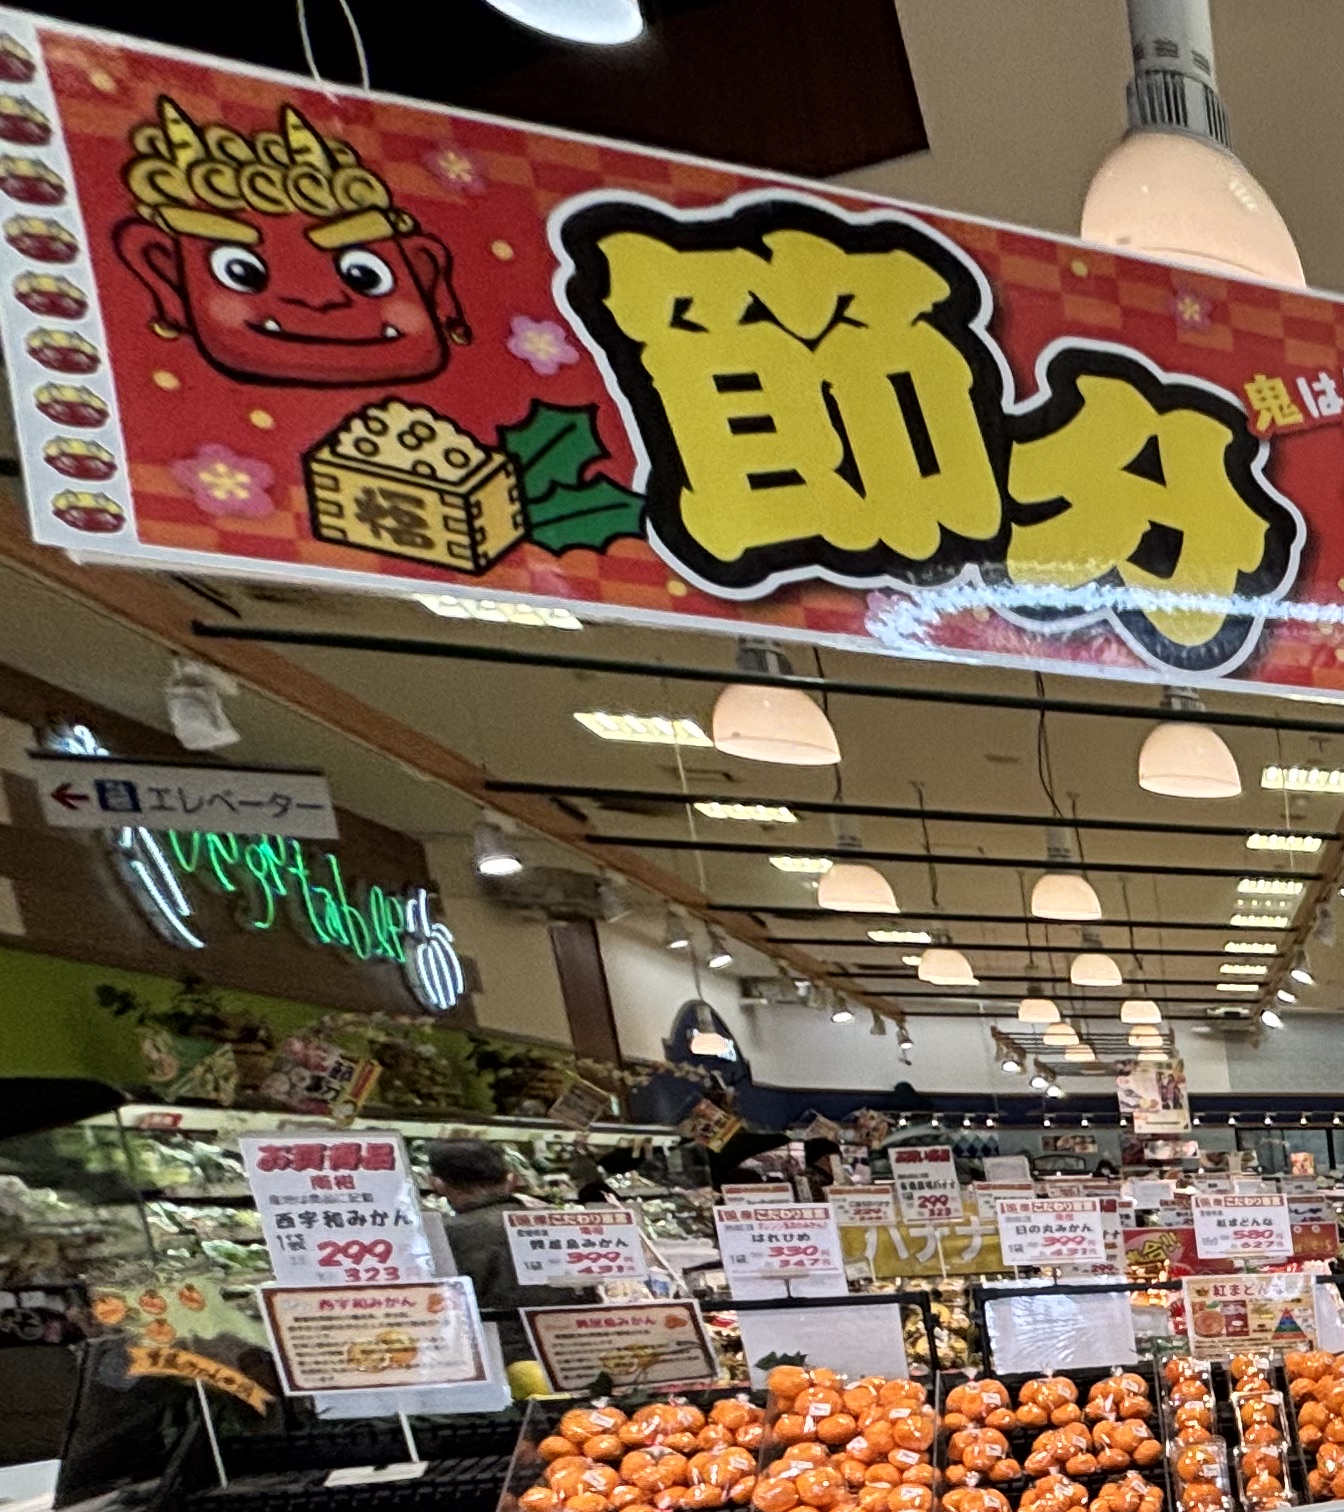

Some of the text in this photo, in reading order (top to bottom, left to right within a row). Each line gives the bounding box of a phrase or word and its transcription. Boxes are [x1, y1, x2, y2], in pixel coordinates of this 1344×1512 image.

[590, 222, 1280, 655] 節分
[148, 786, 325, 819] エレベーター
[918, 1195, 948, 1208] 299
[275, 1210, 413, 1229] 西宇和みかん
[1216, 1218, 1274, 1227] 紅まどんな
[1016, 1223, 1093, 1234] 日の丸みかん
[752, 1233, 811, 1243] はれひめ
[317, 1239, 393, 1267] 299
[345, 1267, 400, 1282] 323
